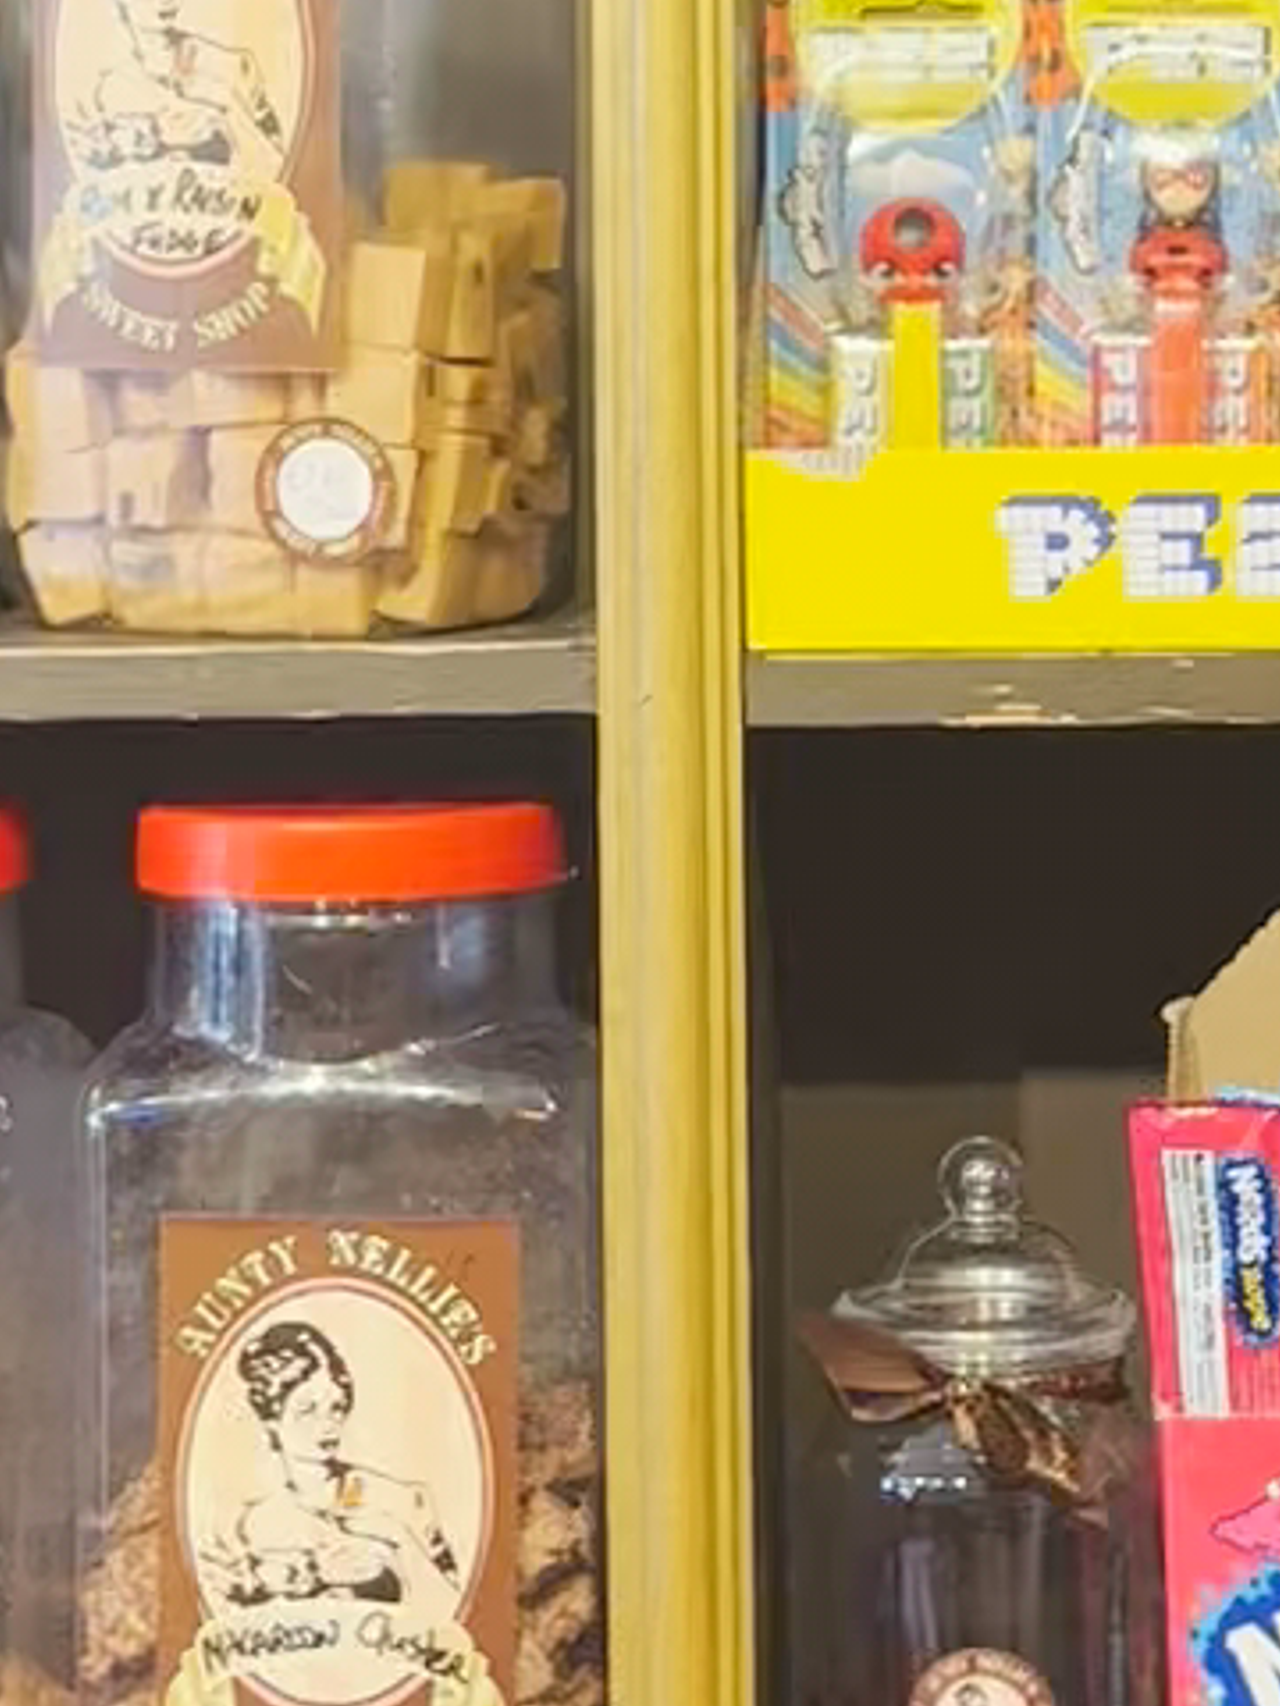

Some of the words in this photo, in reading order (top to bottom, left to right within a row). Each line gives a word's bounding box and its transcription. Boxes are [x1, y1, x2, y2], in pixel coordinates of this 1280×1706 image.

[82, 283, 178, 350] SWEET
[194, 283, 272, 346] SHOP
[176, 1236, 300, 1360] AUNTY
